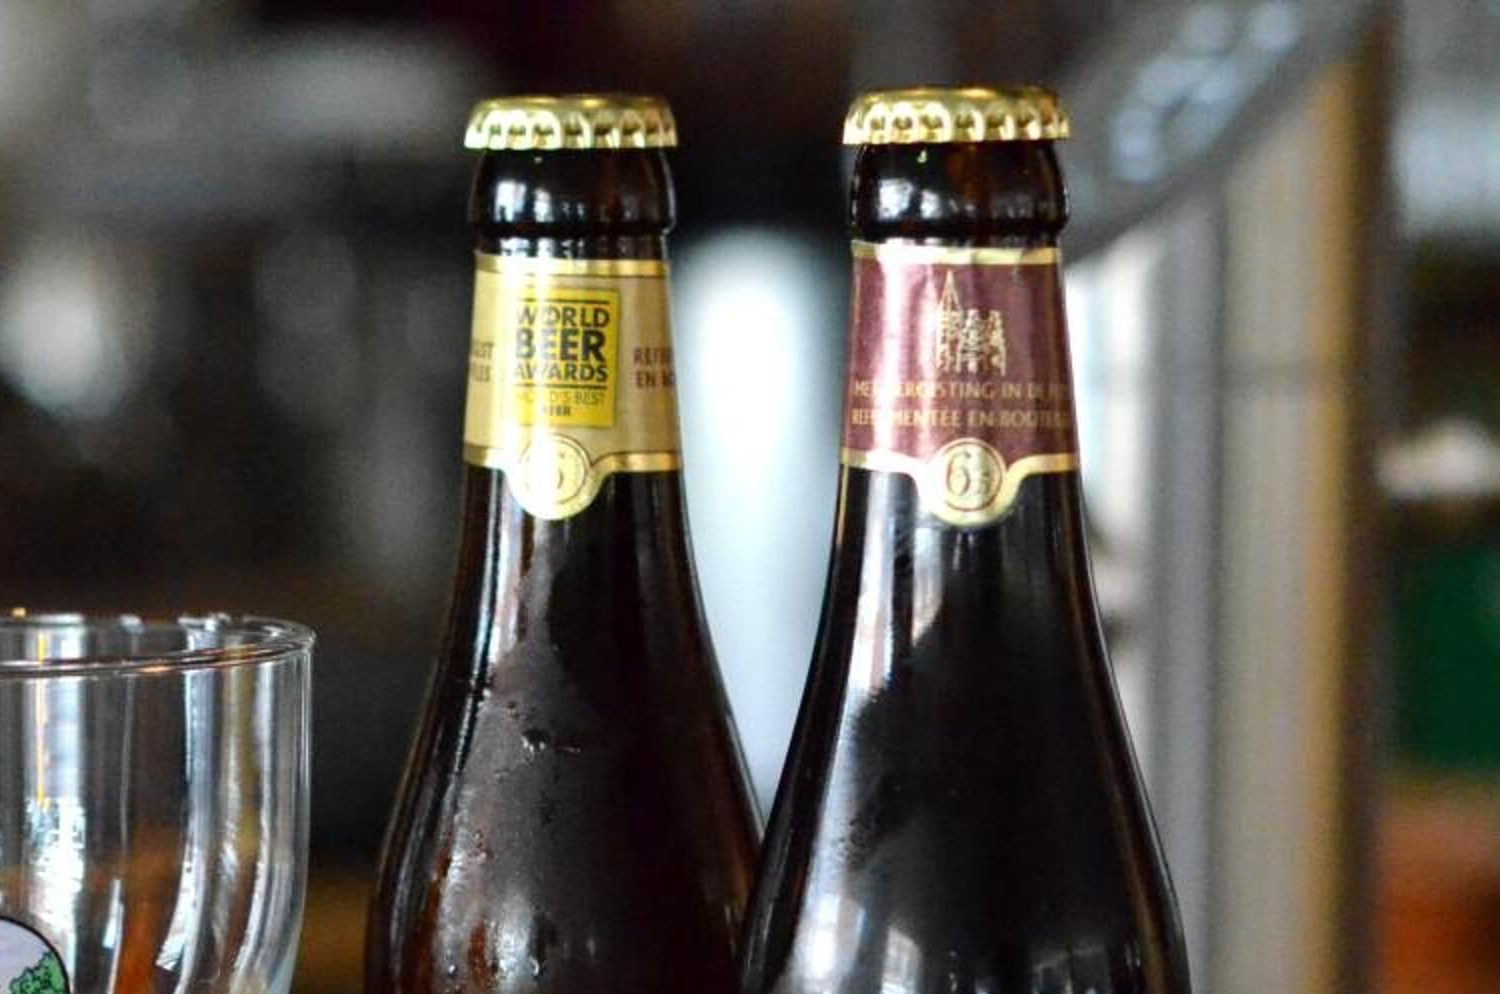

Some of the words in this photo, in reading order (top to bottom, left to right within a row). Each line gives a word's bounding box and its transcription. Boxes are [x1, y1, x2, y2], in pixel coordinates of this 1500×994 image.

[517, 306, 610, 328] WORLD
[516, 329, 607, 362] BEER
[515, 363, 608, 382] AWARDS
